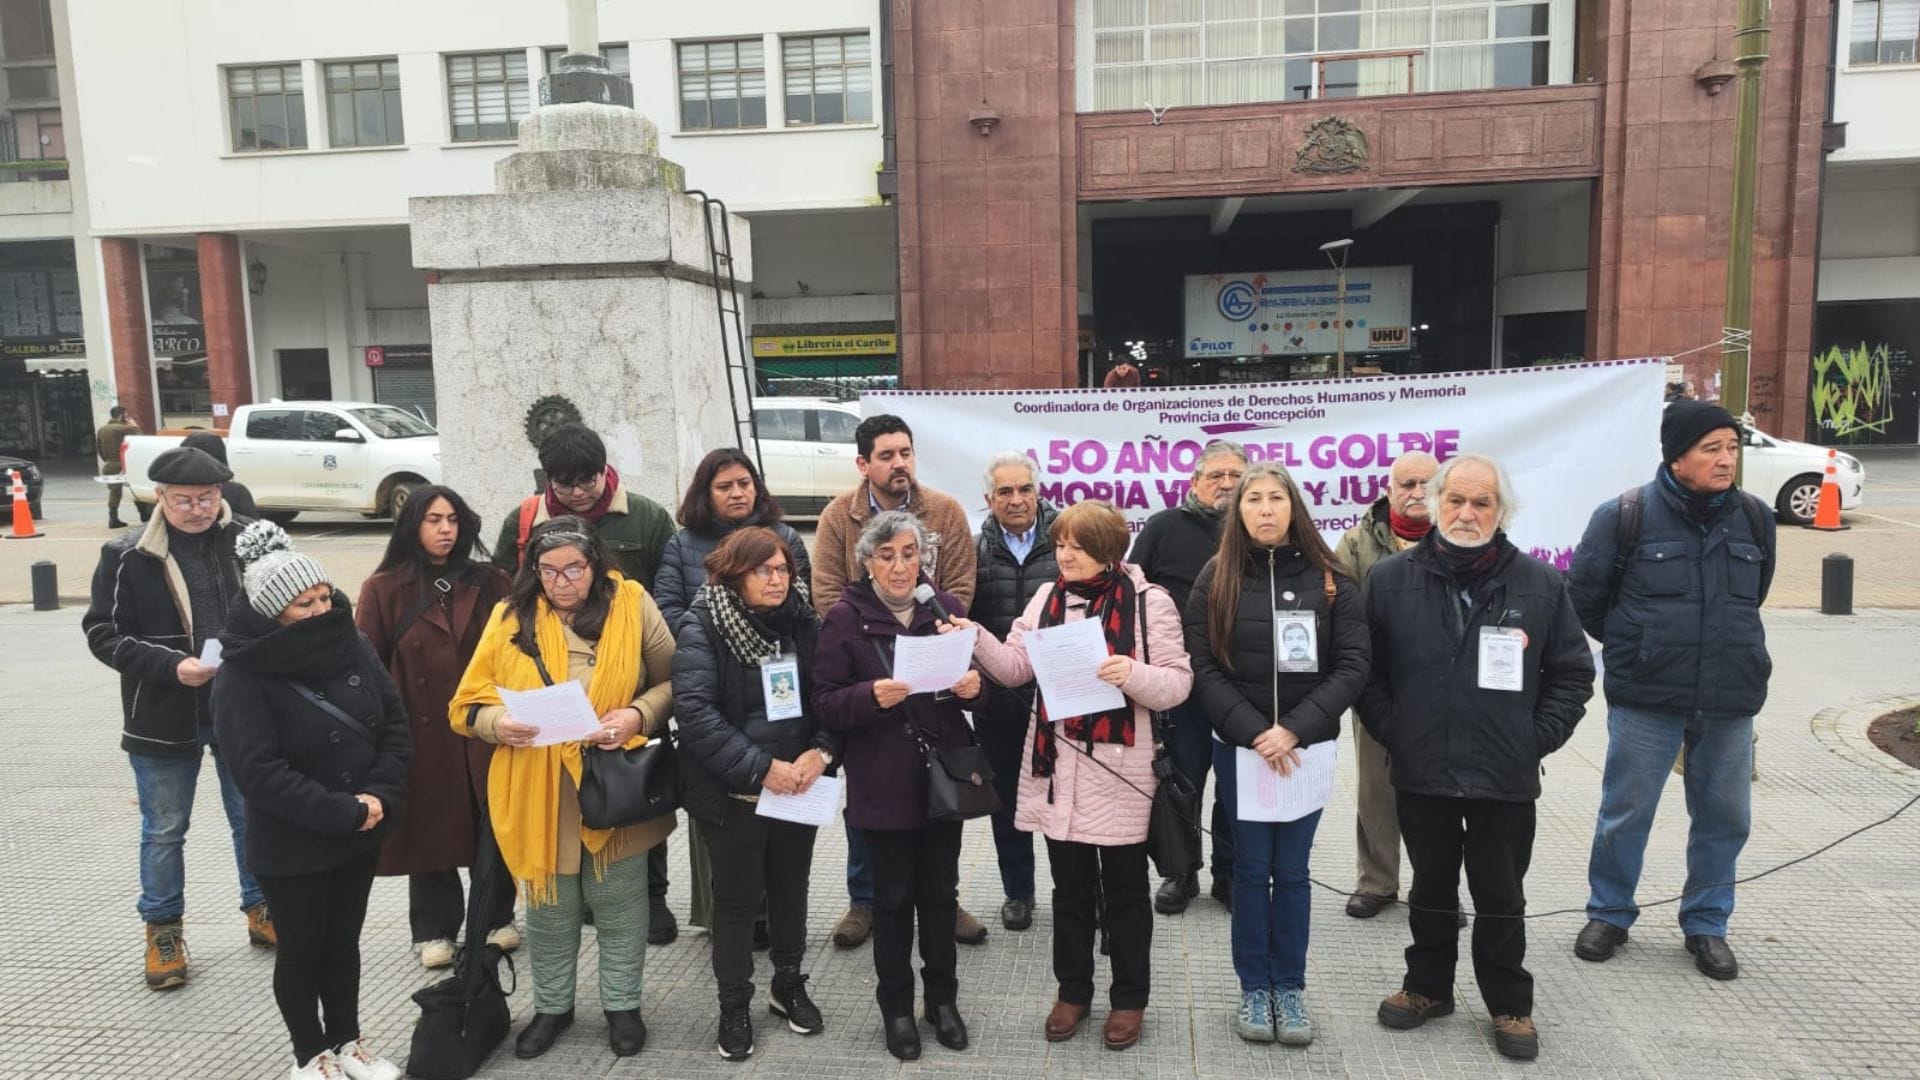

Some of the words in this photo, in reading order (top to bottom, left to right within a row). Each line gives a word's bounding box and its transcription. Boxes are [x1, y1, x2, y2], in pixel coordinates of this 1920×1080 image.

[844, 339, 854, 348] el
[856, 338, 890, 348] Caribe
[1372, 329, 1404, 342] UHU
[154, 337, 200, 353] ARCO
[1201, 341, 1234, 351] PILOT
[1014, 401, 1100, 413] Coordinadora
[1103, 400, 1119, 412] de
[1122, 397, 1224, 414] Organizaciones
[1228, 396, 1245, 407] de
[1248, 393, 1314, 406] Derechos
[1317, 391, 1385, 403] Humanos
[1388, 390, 1397, 402] y
[1400, 384, 1466, 399] Memoria
[1159, 410, 1220, 424] Provincia
[1223, 410, 1240, 421] de
[1244, 407, 1326, 423] Concepción
[1047, 439, 1108, 475] 50
[1113, 434, 1223, 475] AÑO
[1243, 442, 1302, 467] DEL
[1309, 430, 1460, 470] GOLPE
[1303, 481, 1327, 506] Y
